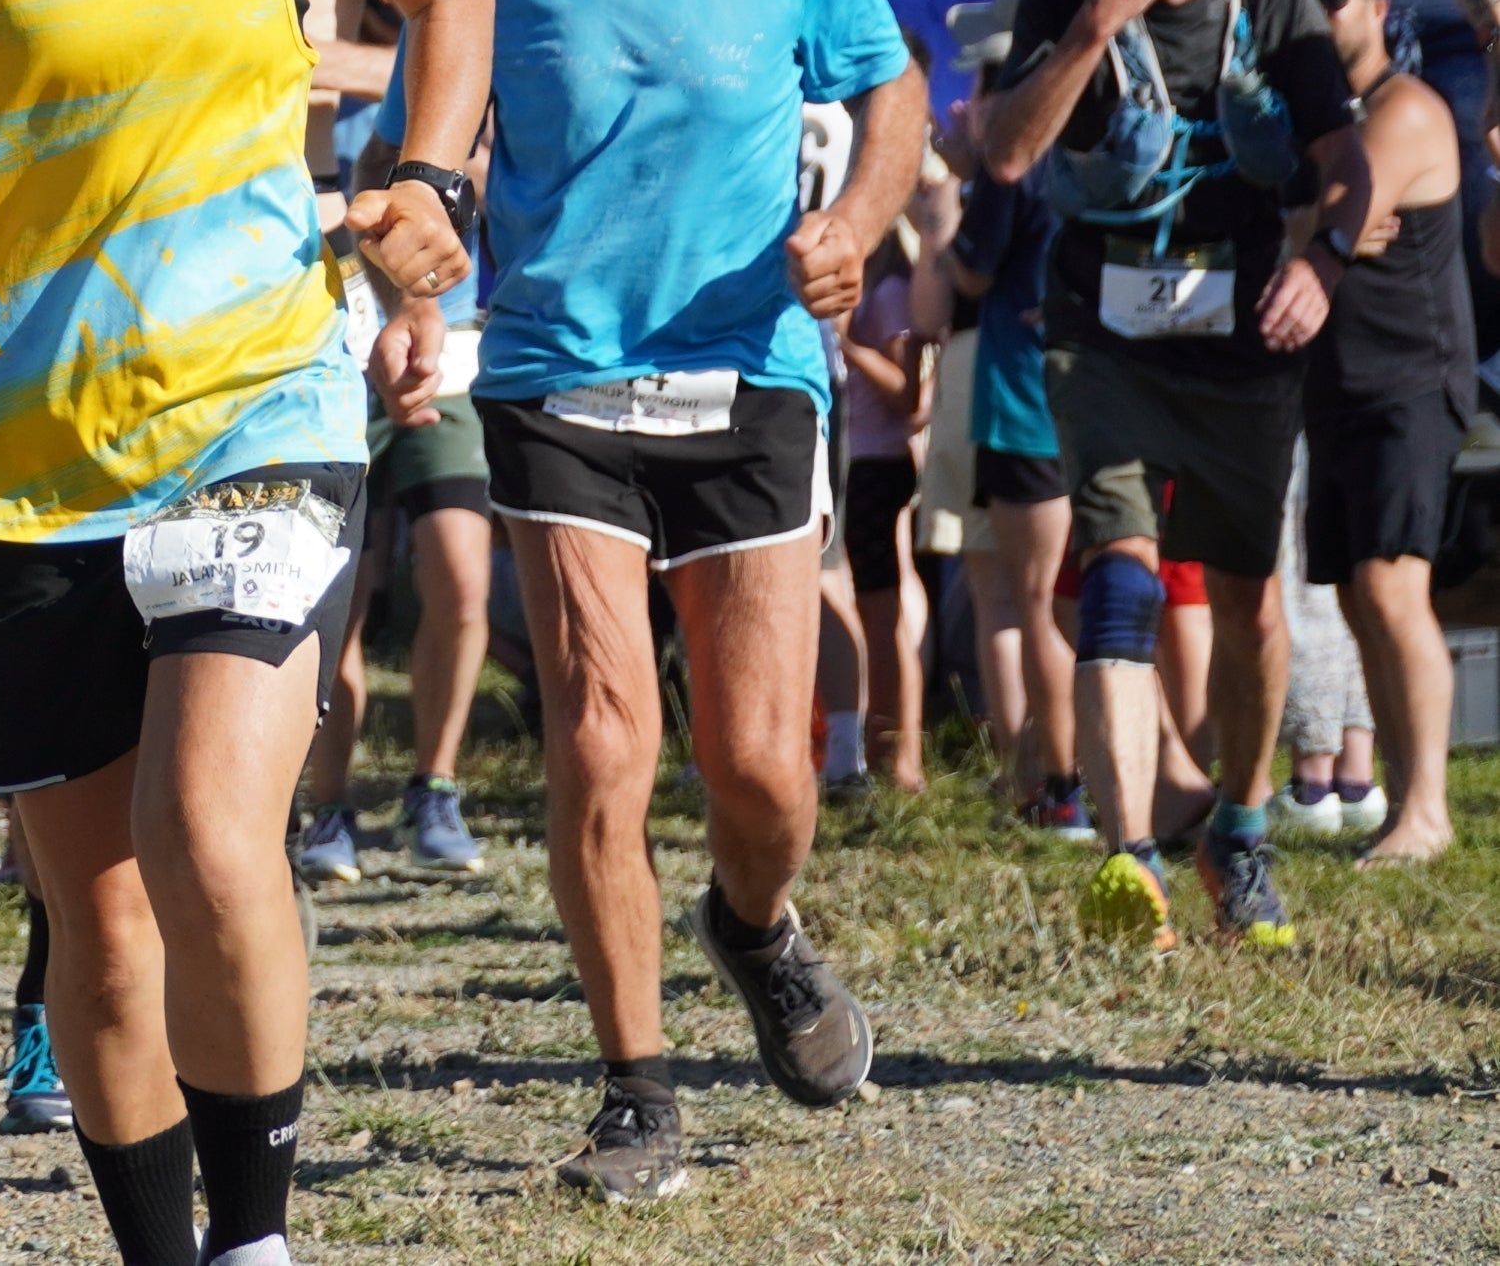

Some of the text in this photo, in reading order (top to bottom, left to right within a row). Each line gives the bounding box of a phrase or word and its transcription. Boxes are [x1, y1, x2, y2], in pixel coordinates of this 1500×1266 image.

[1149, 275, 1177, 303] 21
[212, 520, 266, 559] 19
[241, 562, 301, 580] SMITH
